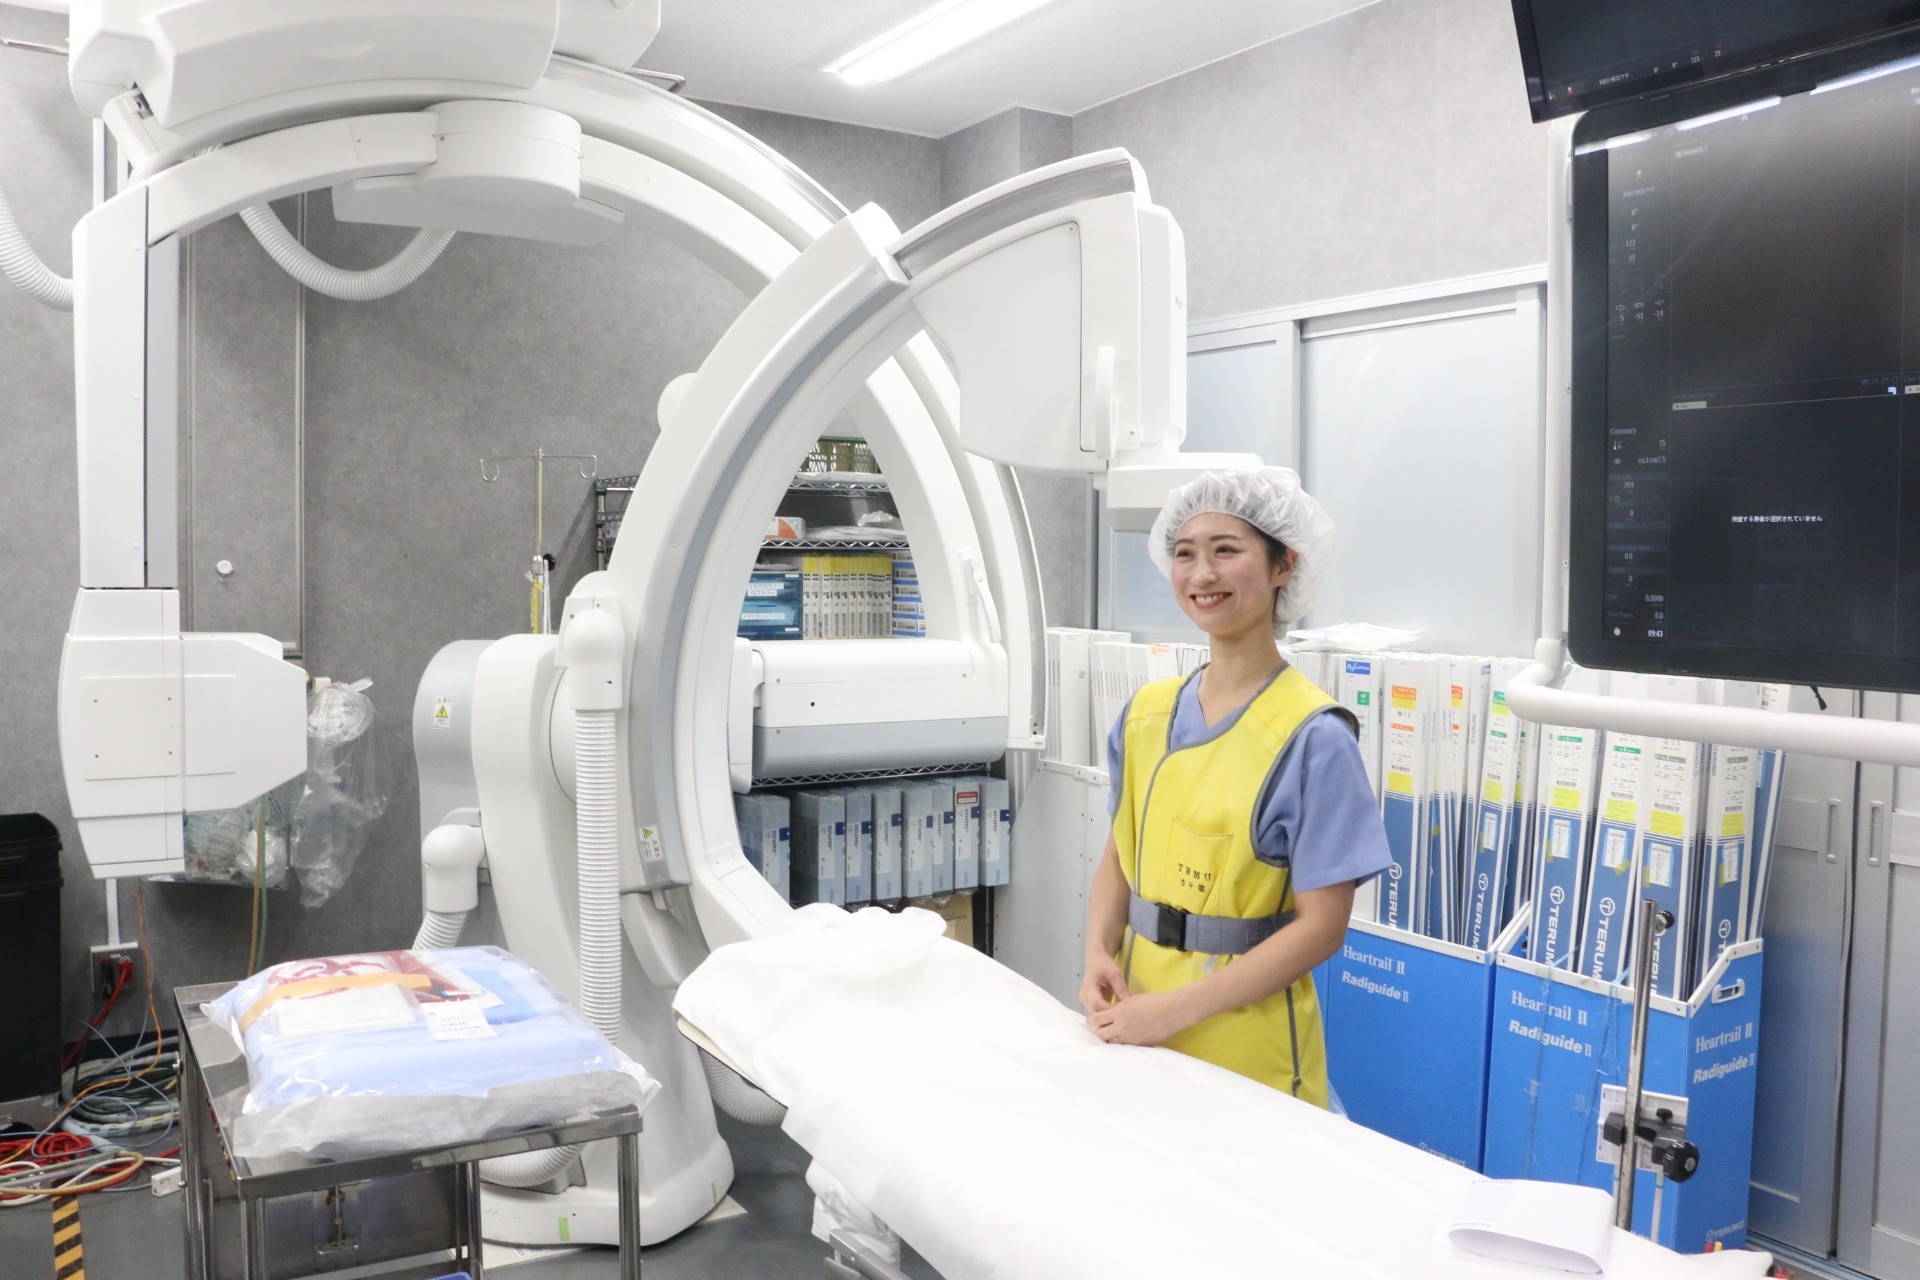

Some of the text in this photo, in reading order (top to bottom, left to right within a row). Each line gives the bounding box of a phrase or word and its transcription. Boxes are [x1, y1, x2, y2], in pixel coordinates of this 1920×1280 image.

[1626, 239, 1636, 248] 123
[1610, 427, 1637, 436] Coronary
[1647, 629, 1663, 638] 09:43
[1388, 880, 1398, 928] TERU
[1472, 891, 1484, 949] TERUM
[1545, 905, 1559, 966] TERUM
[1592, 917, 1609, 980] TERUM
[1343, 944, 1393, 971] Heartrail
[1342, 970, 1401, 1000] Radiguide
[1509, 1019, 1583, 1054] Radiguide
[1695, 1025, 1741, 1054] Heartrail
[1693, 1055, 1748, 1084] Radiguide
